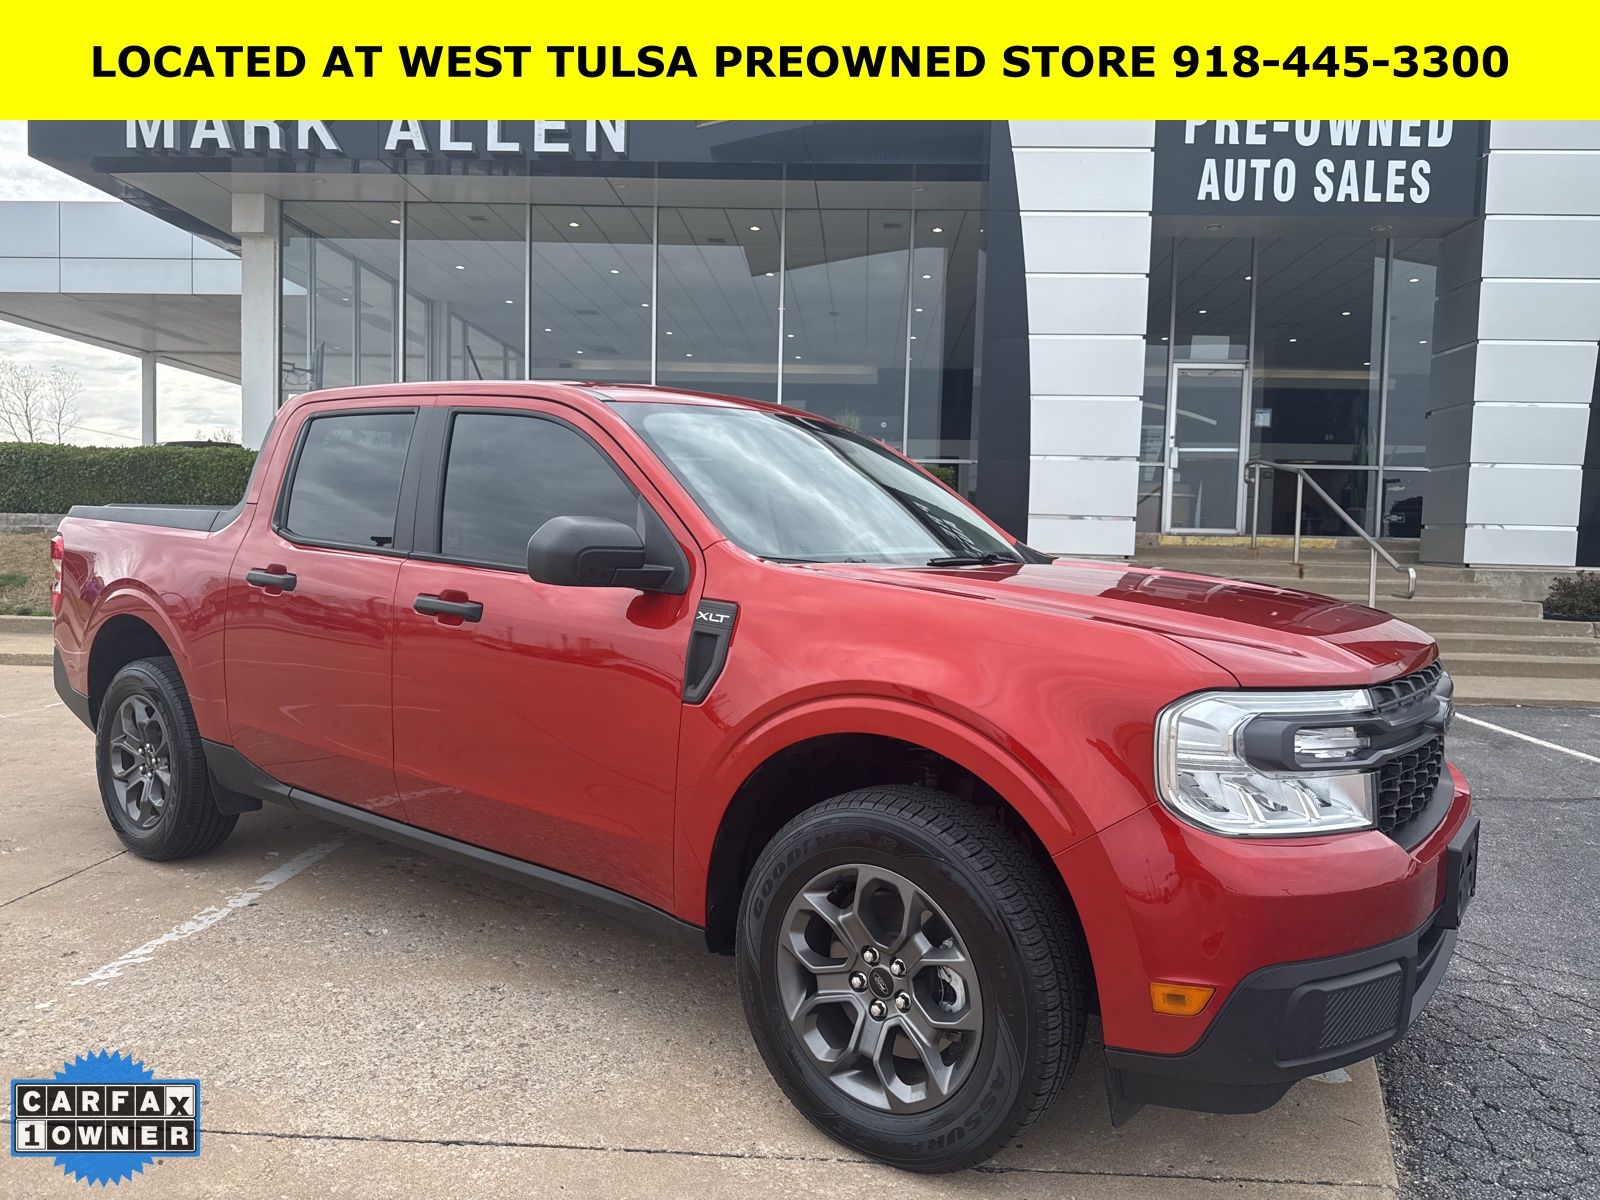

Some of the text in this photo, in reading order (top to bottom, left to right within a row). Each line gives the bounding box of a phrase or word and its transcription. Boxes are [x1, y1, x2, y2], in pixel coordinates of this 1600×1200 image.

[126, 120, 625, 153] MARK ALLEN
[1184, 120, 1453, 147] PRE-OWNED
[1197, 158, 1431, 204] AUTO SALES
[696, 610, 730, 623] XLT
